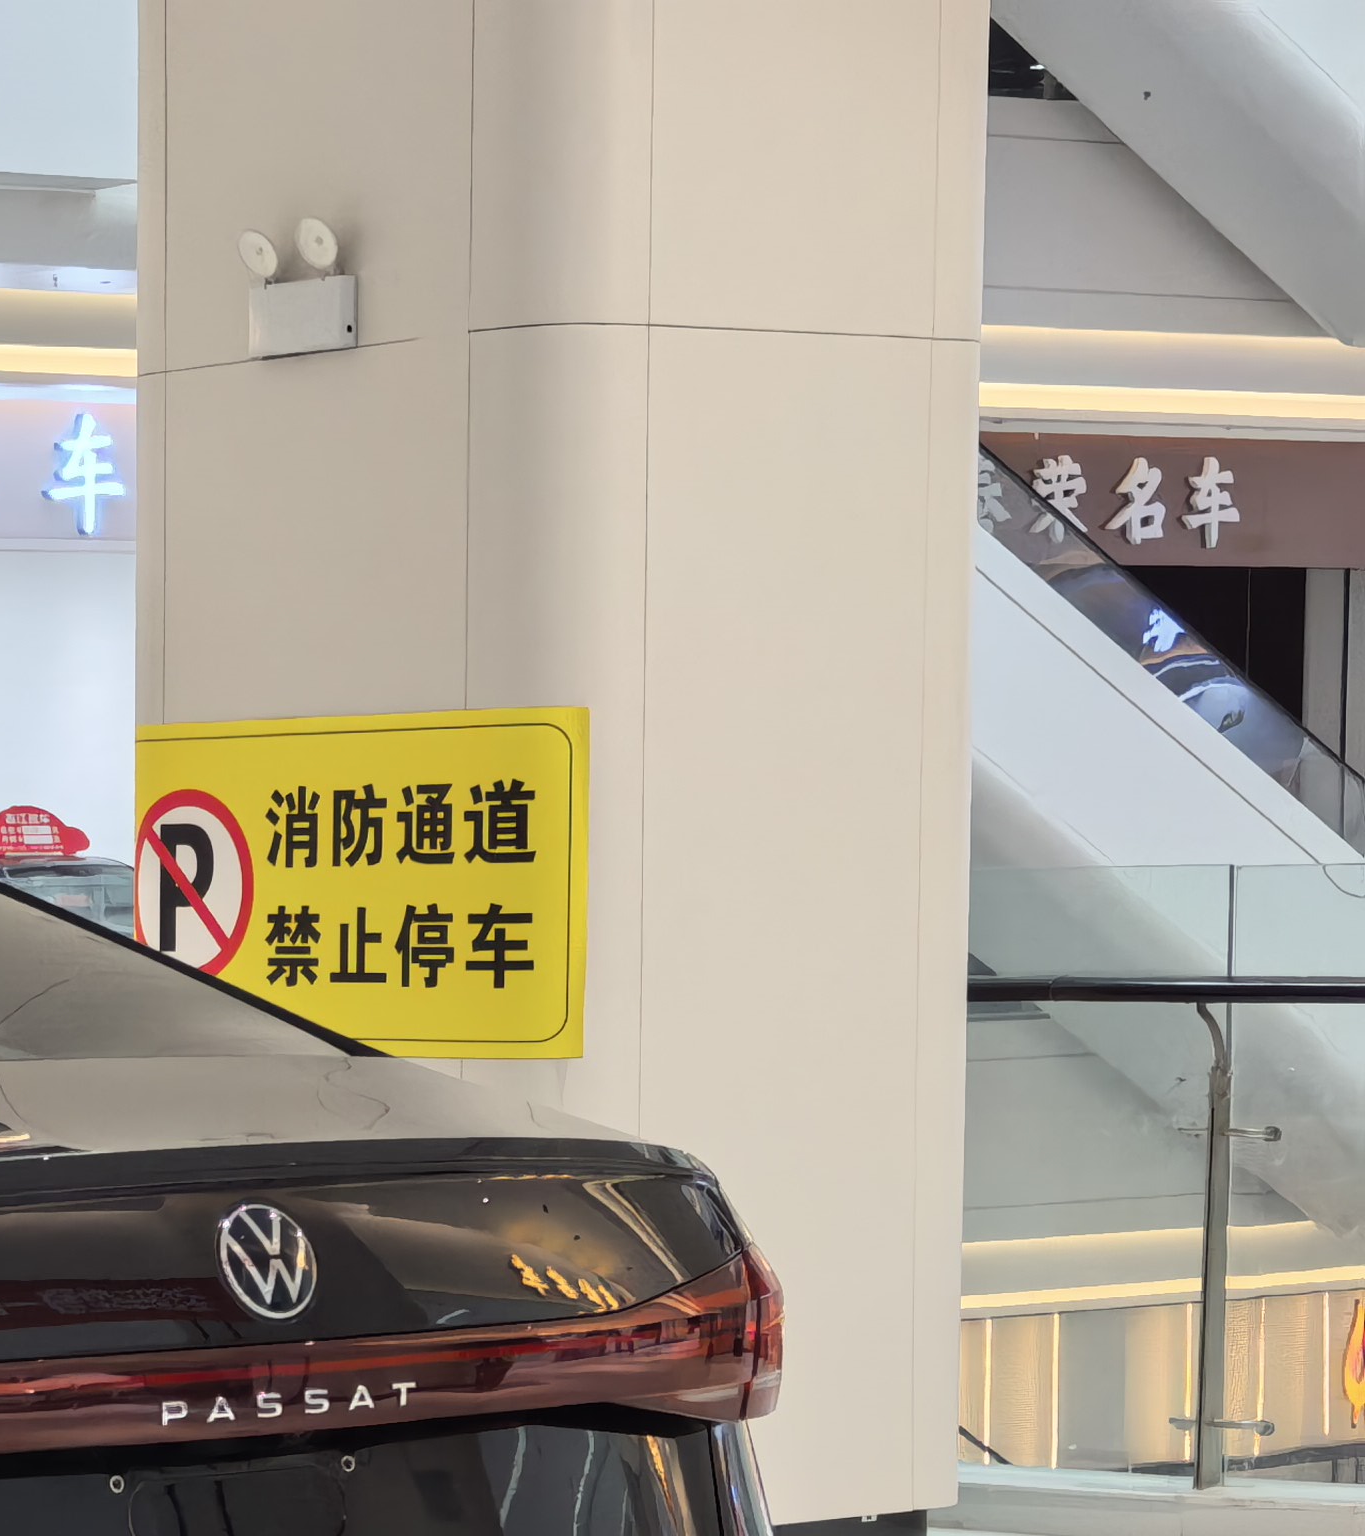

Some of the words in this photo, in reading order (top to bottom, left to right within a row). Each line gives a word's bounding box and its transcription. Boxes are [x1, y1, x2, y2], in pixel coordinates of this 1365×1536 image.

[265, 778, 536, 868] 消防通道
[265, 903, 535, 988] 禁止停车
[162, 1382, 416, 1426] PASSAT
